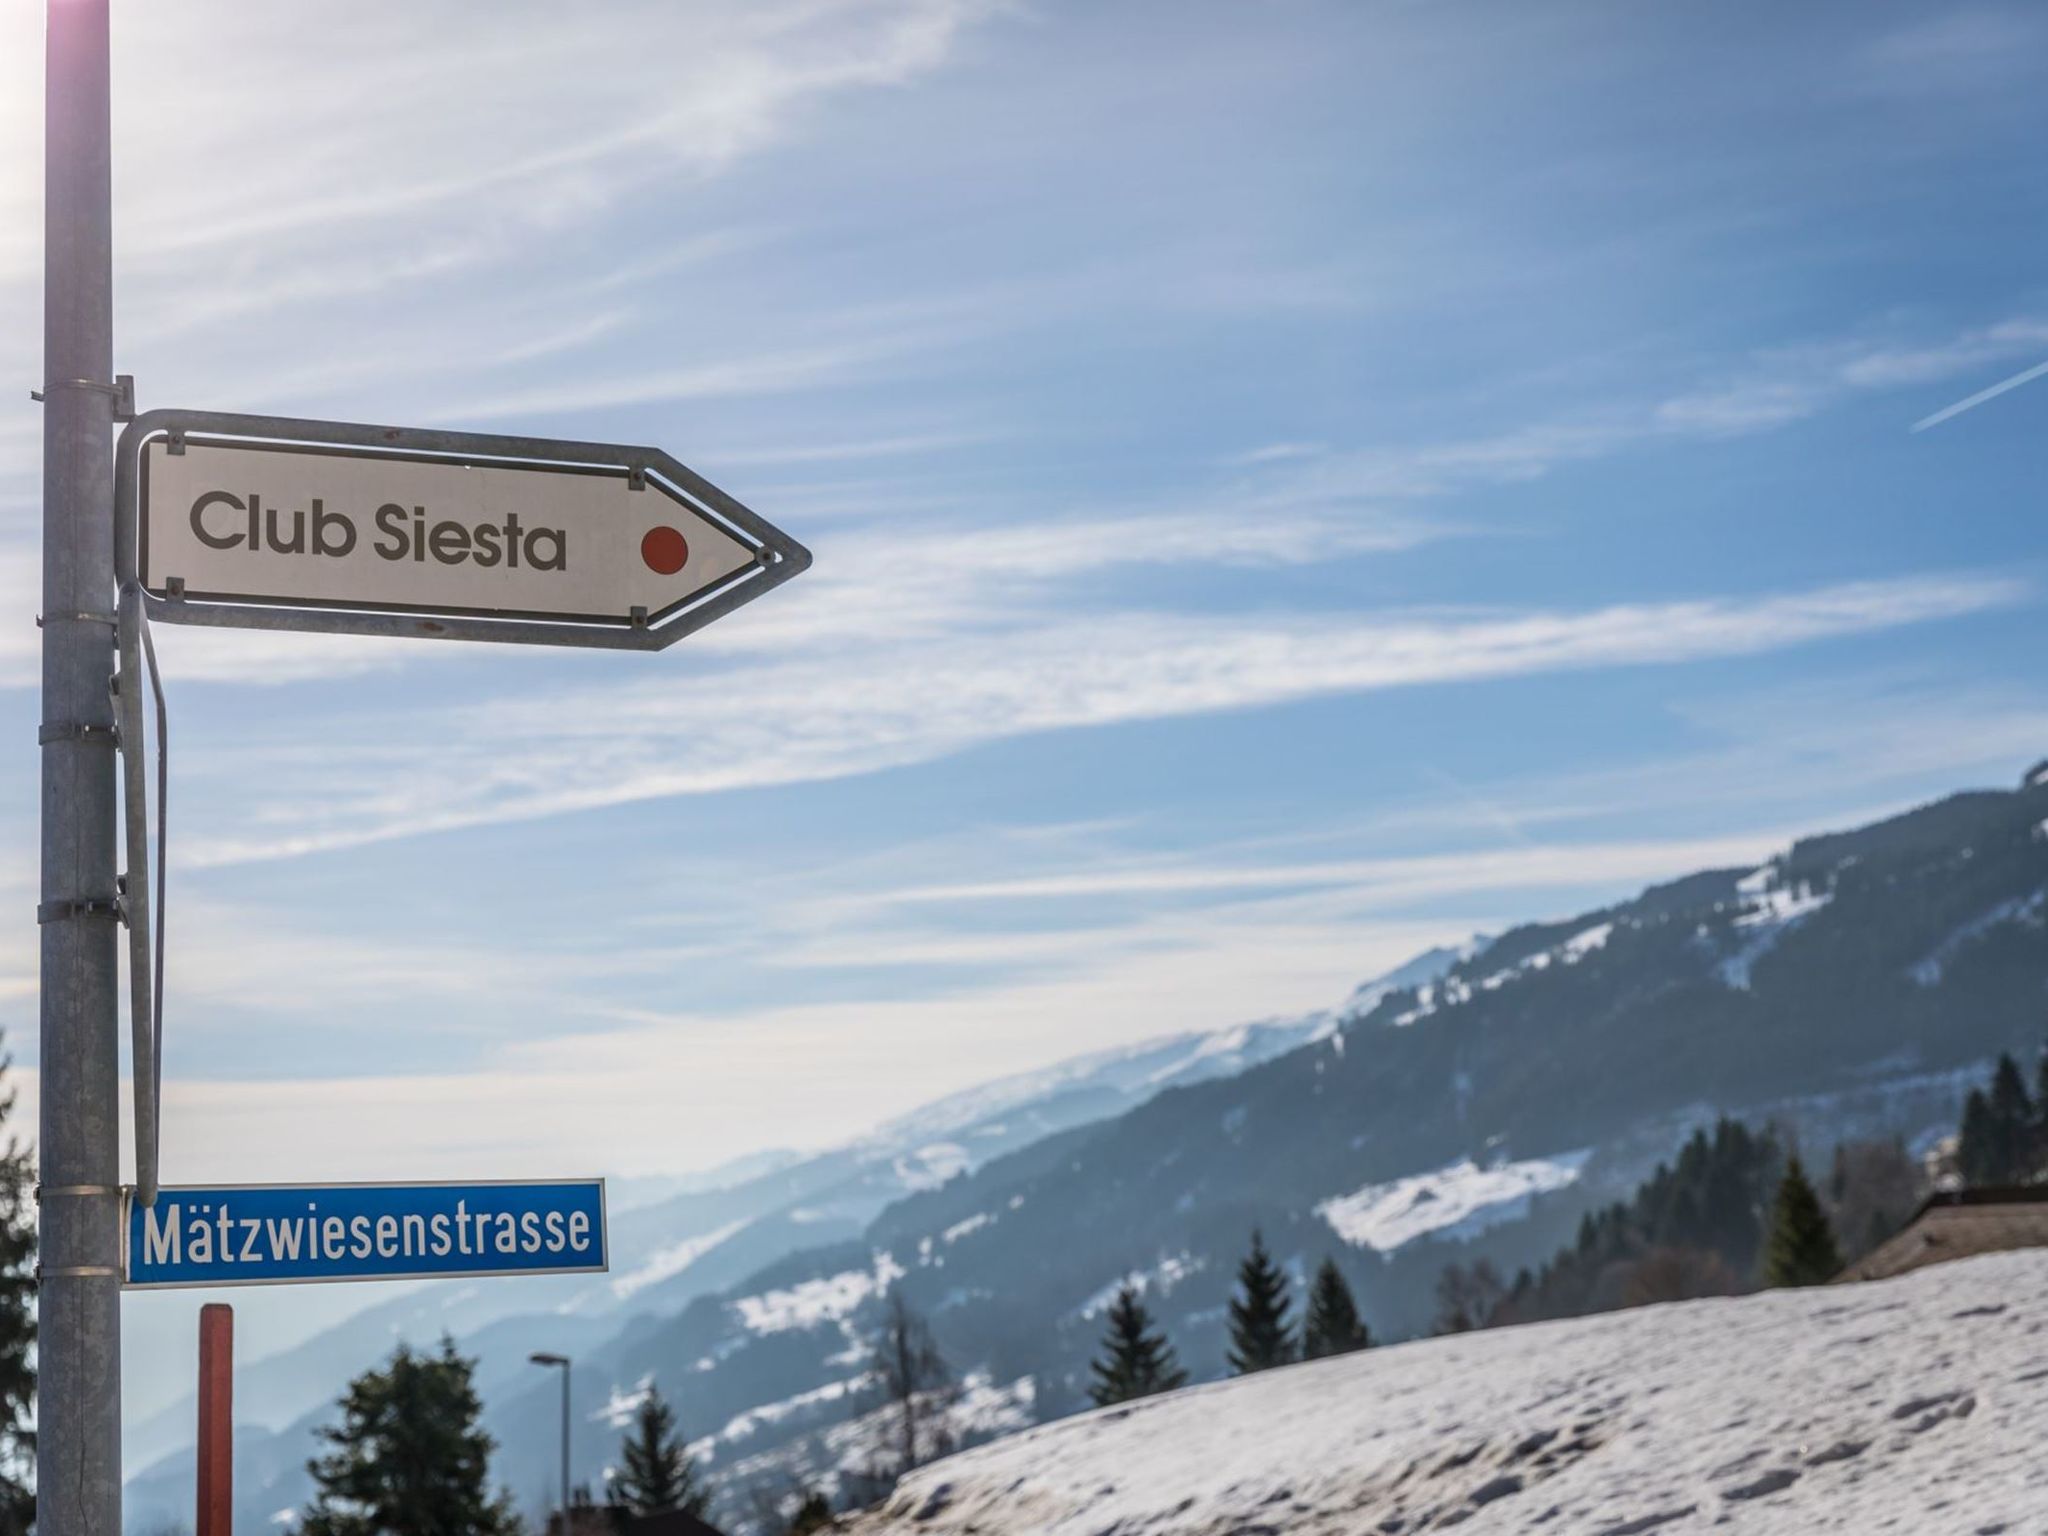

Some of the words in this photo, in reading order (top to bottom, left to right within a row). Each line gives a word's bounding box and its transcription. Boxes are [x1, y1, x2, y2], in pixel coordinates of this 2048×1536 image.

[190, 490, 357, 557] Club
[374, 503, 567, 571] Siesta
[143, 1199, 590, 1265] Mätzwiesenstrasse
